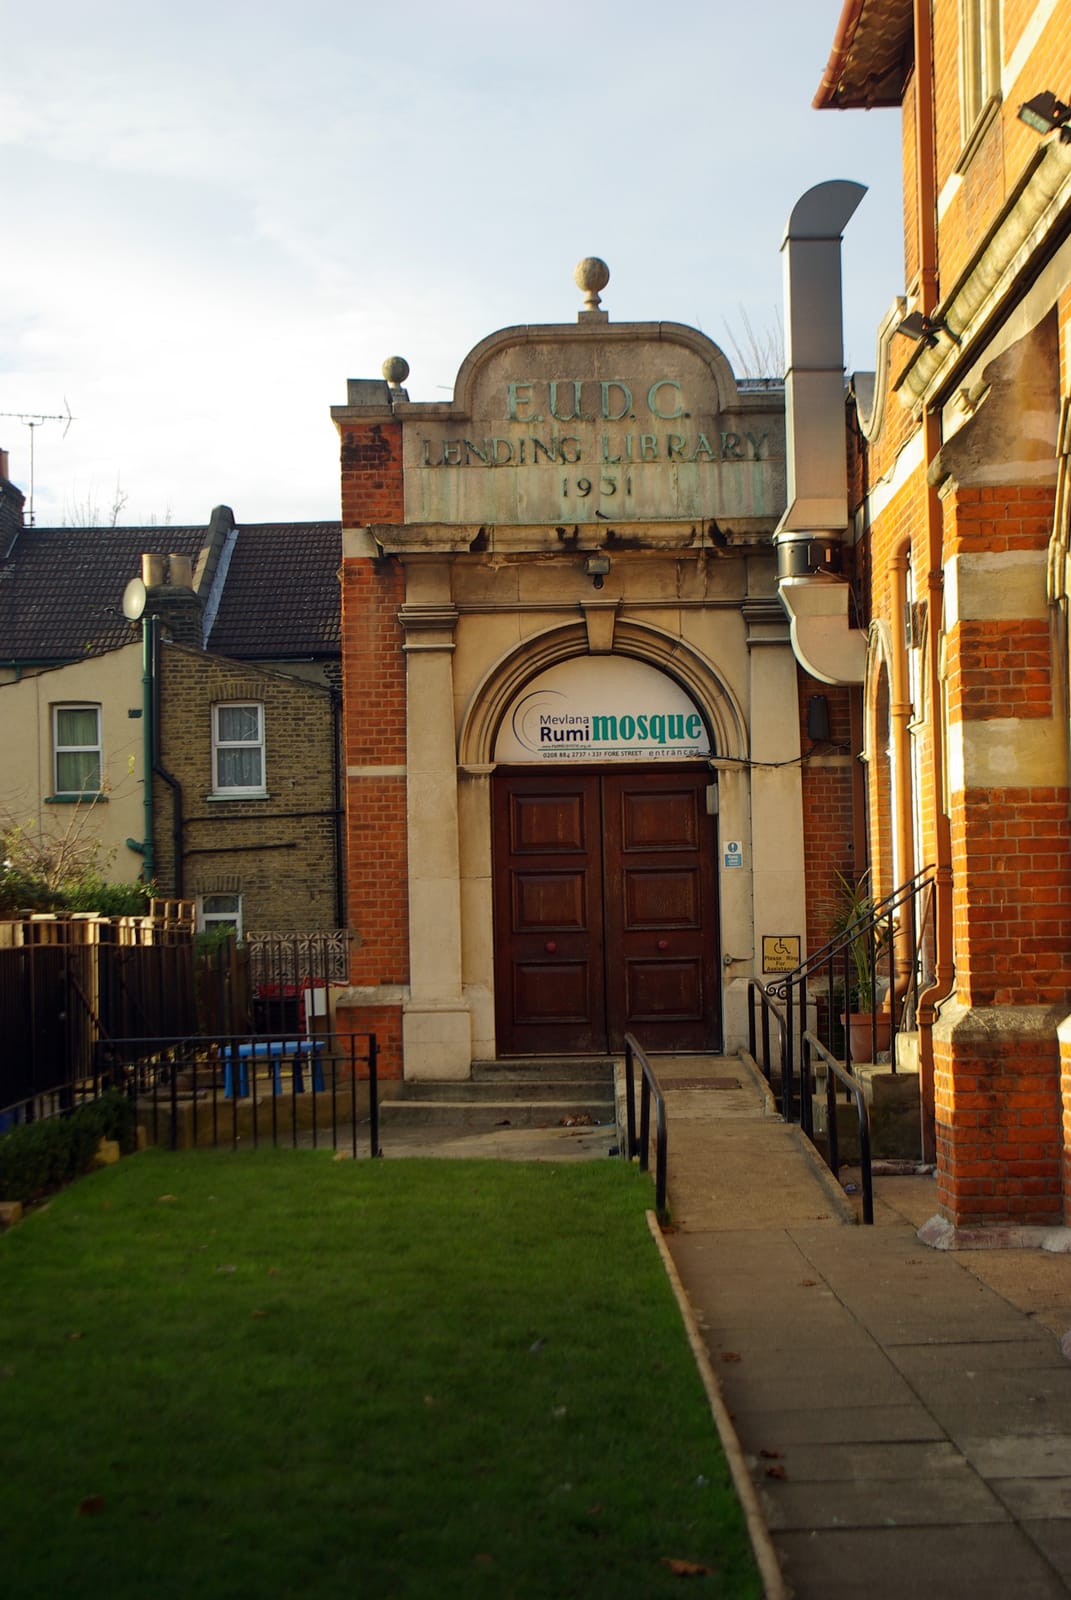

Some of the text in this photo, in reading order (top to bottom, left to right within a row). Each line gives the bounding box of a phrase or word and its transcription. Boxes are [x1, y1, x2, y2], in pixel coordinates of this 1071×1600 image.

[421, 432, 768, 466] LENDING LIBRARY
[540, 714, 701, 744] Mevlana mosque
[540, 726, 590, 742] Rumi
